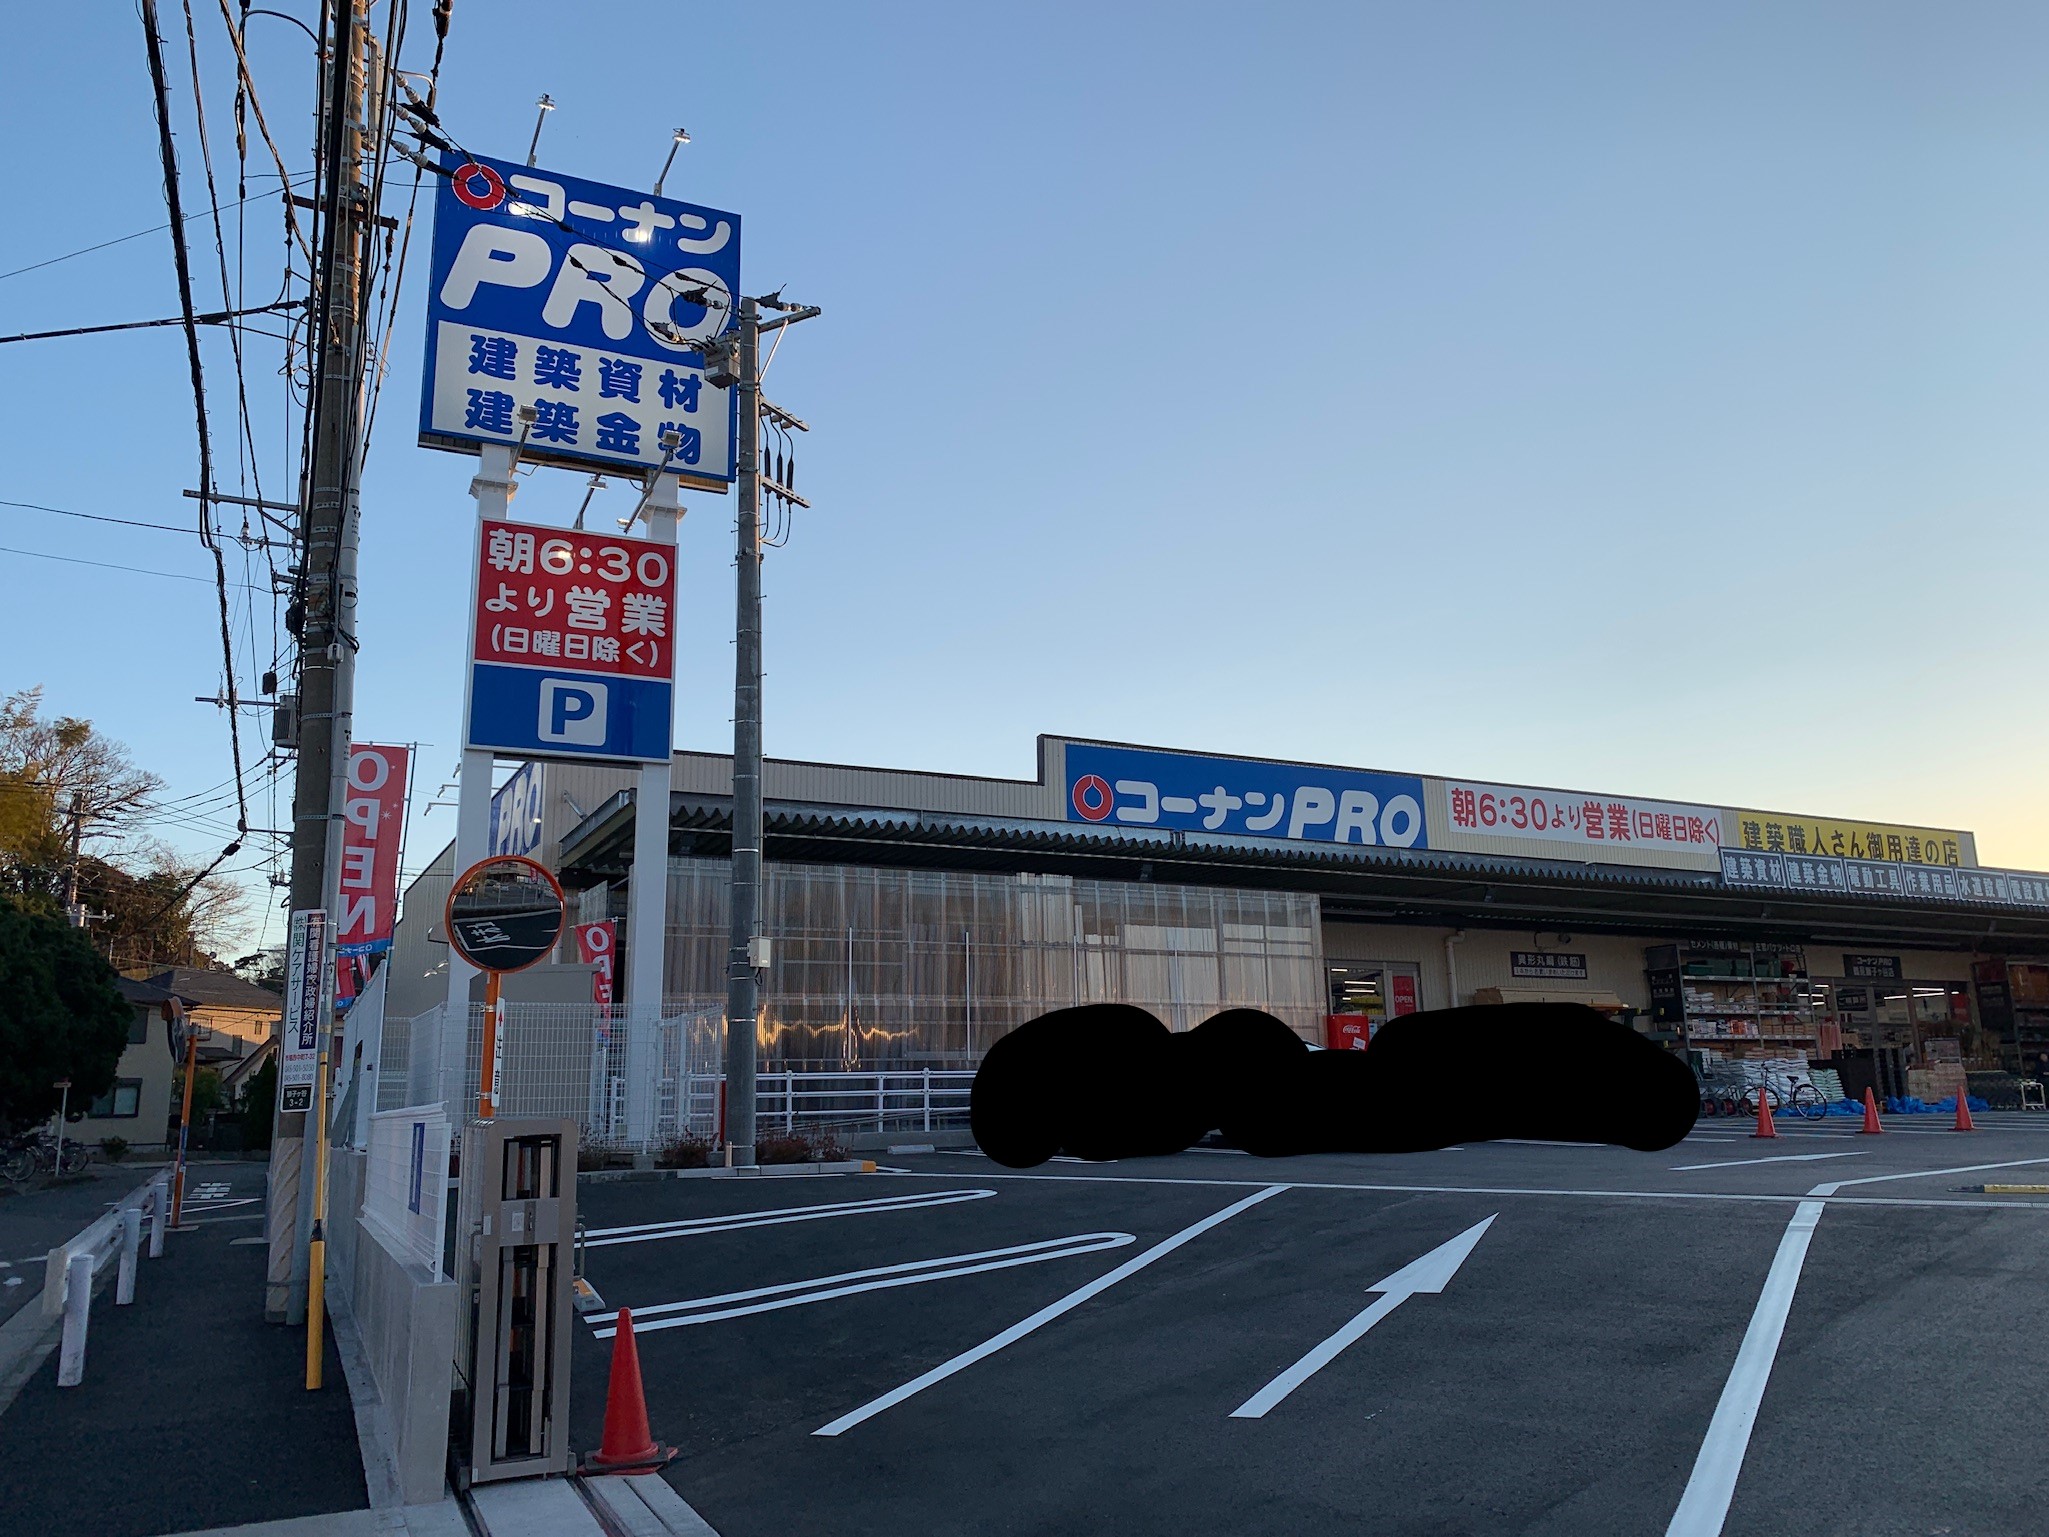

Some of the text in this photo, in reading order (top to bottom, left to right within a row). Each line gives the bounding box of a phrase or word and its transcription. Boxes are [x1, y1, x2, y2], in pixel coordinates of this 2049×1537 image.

[509, 173, 731, 255] コーナン
[440, 223, 731, 352] PRO
[468, 333, 703, 414] 建築資材
[465, 388, 701, 465] 建築金物
[487, 528, 669, 588] 朝6:30
[484, 582, 668, 637] より営業
[491, 623, 659, 668] (日曜日除く)
[551, 686, 595, 736] P
[495, 762, 542, 856] PRO
[1724, 855, 1783, 882] 建築資材
[1742, 820, 1960, 868] 建築職人さん御用達の店
[1787, 861, 1844, 887] 建築金物
[1850, 865, 1902, 891] 電動工具
[1905, 870, 1956, 895] 作業用品
[1394, 995, 1413, 1003] OPEN
[289, 1098, 304, 1107] 3-2
